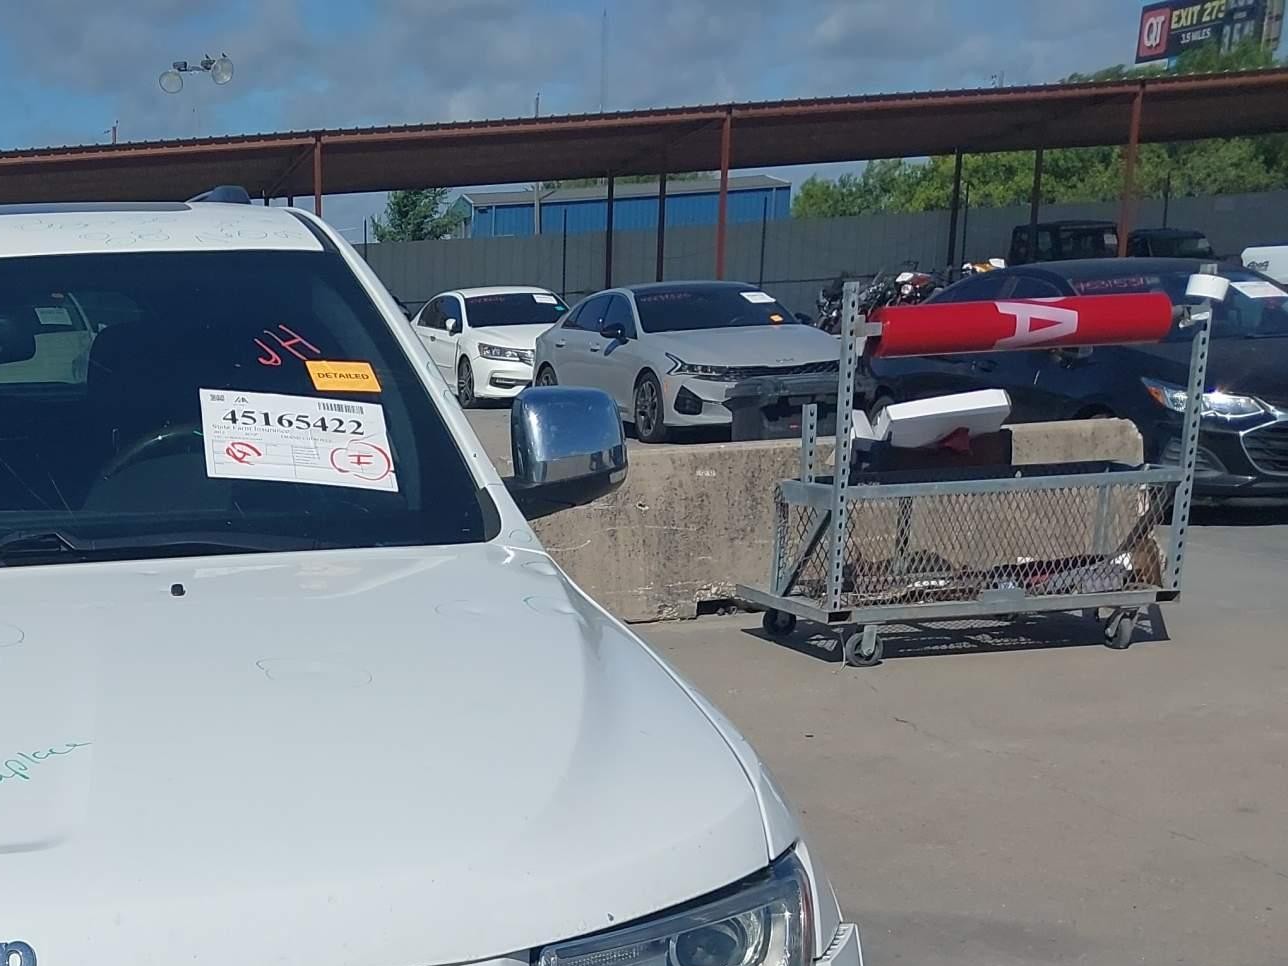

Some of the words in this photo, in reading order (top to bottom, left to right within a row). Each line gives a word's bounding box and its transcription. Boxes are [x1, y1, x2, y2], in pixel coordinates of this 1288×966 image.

[1171, 5, 1202, 29] EXIT
[1143, 16, 1165, 48] QT
[1192, 28, 1211, 41] MILES
[316, 372, 370, 381] DETAILED
[222, 409, 365, 436] 45165422
